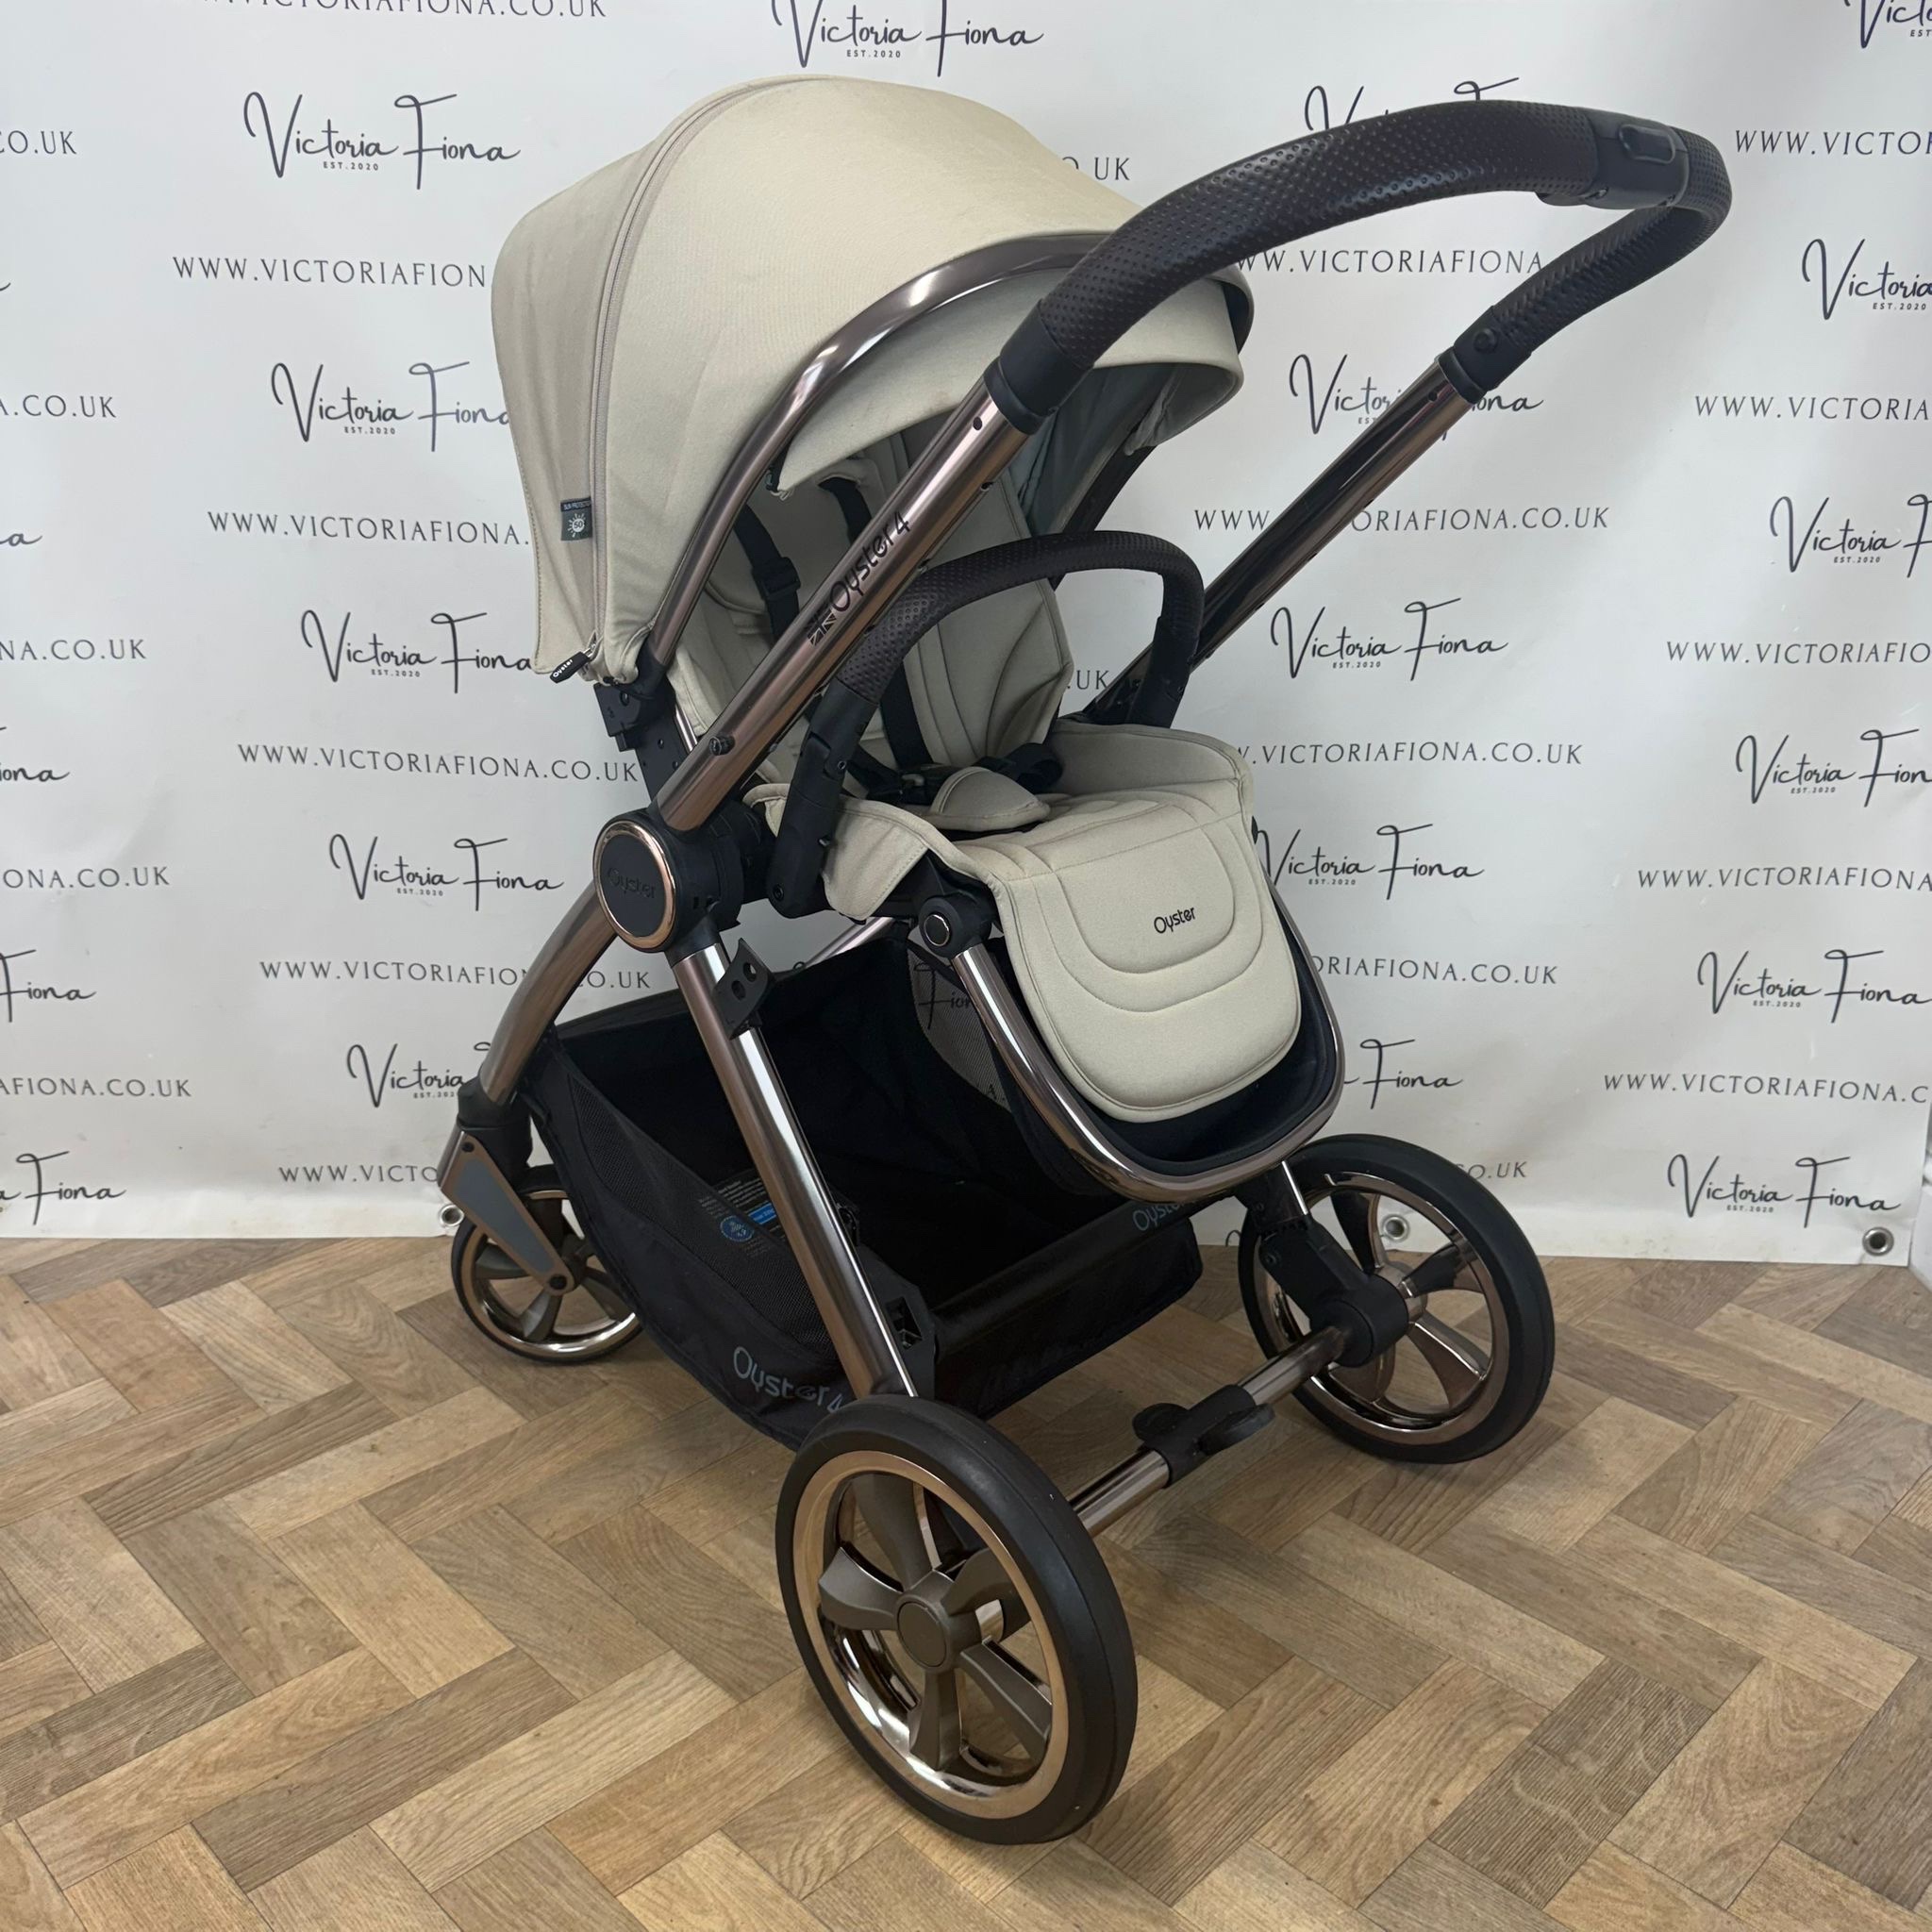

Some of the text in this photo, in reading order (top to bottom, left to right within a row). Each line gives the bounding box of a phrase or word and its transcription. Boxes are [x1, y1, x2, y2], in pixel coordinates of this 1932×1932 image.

[243, 92, 521, 190] Victoria Fiona
[324, 161, 378, 171] EST.2020
[271, 362, 413, 442] Victoria
[1695, 396, 1928, 420] WWW.VICTORIA
[830, 524, 894, 611] Oyster
[1770, 496, 1902, 573] Victoria
[301, 609, 530, 693] Victoria Fiona
[372, 669, 420, 677] EST.2020
[1271, 598, 1508, 681] Victoria Fiona
[1667, 641, 1930, 664] WWW.VICTORIAFIO
[238, 744, 638, 781] WWW.VICTORIAFIONA.CO.UK
[1736, 735, 1857, 804] Victoria
[3, 867, 169, 888] ONA.CO.UK
[329, 834, 564, 911] Victoria Fiona
[397, 888, 442, 896] EST.2020
[607, 867, 655, 899] Oyster
[1257, 824, 1485, 900] Victoria Fiona
[1154, 908, 1195, 934] Oyster
[1697, 949, 1932, 1024] Victoria Fiona
[346, 1043, 464, 1108] Victoria
[1359, 1039, 1463, 1109] Fiona
[16, 1151, 125, 1225] Fiona
[1668, 1154, 1901, 1228] Victoria Fiona
[733, 1346, 830, 1406] Oyster
